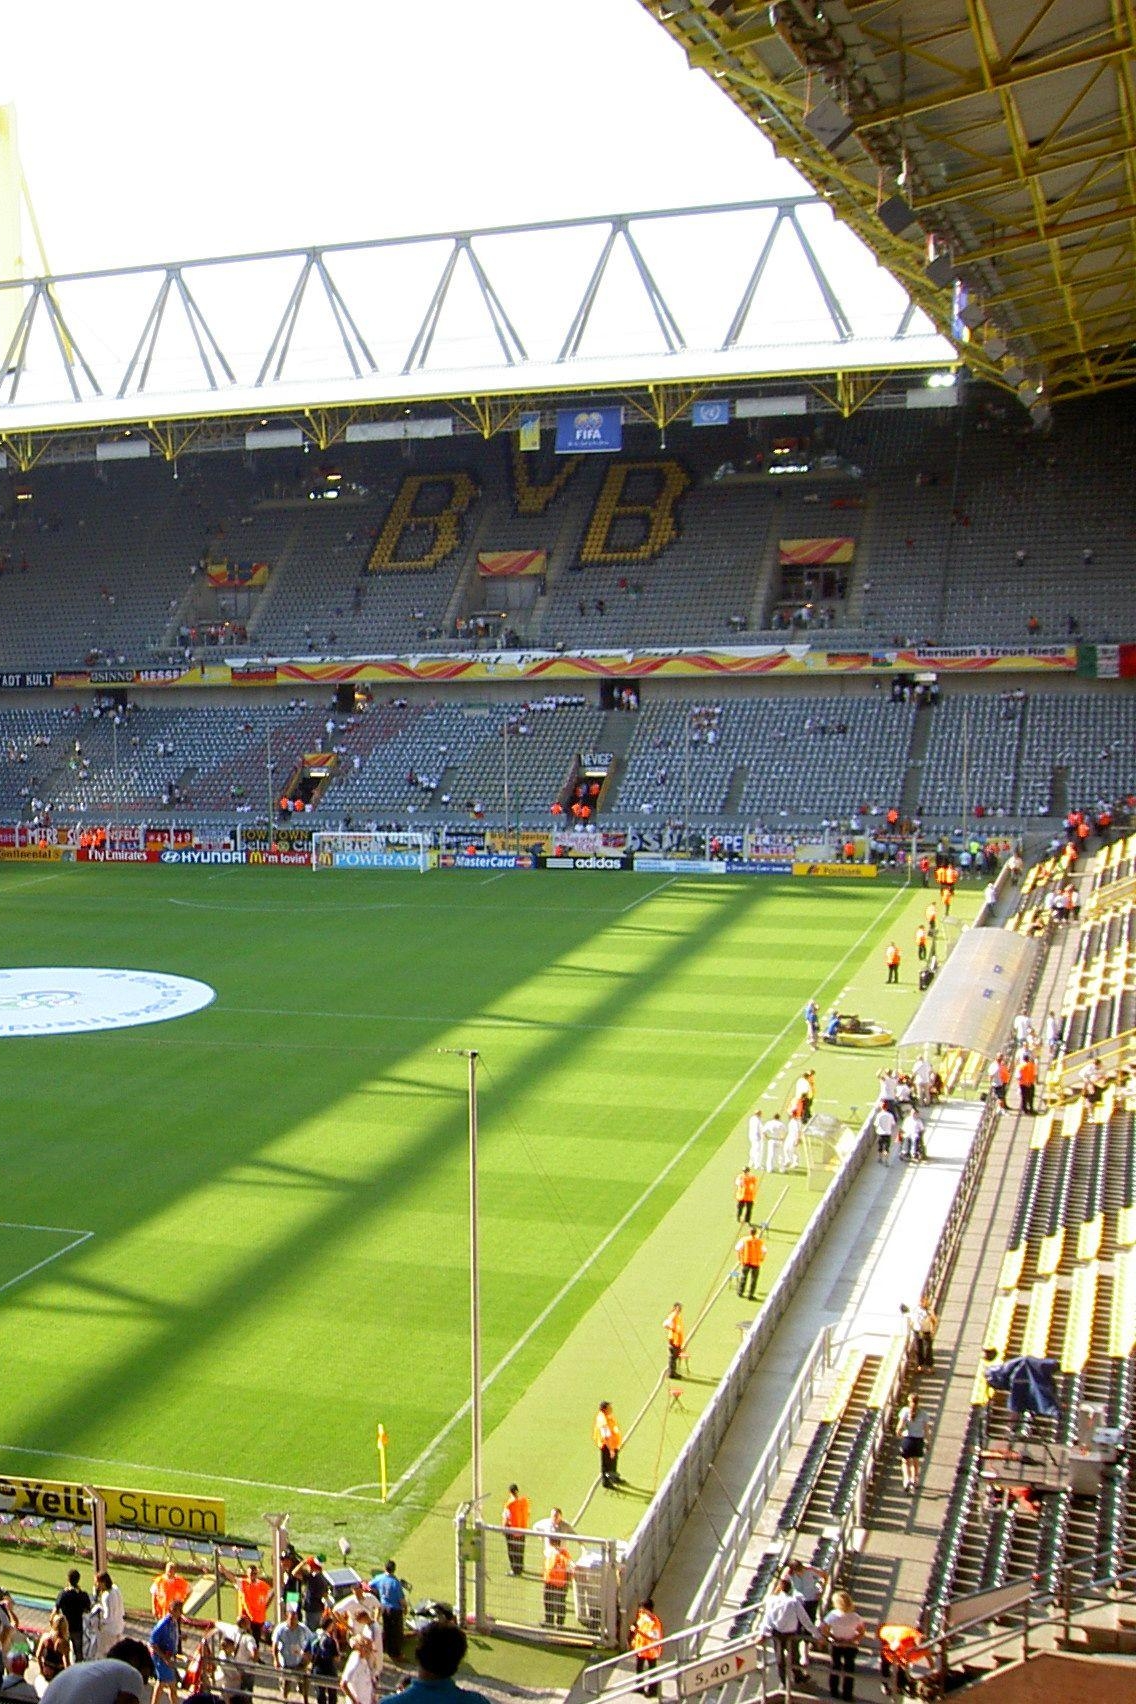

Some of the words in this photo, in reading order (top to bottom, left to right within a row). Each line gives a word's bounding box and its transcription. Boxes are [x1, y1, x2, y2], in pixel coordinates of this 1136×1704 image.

[575, 429, 601, 440] FIFA
[88, 849, 104, 862] Fly
[105, 850, 147, 861] Emirates
[181, 851, 246, 864] HYUNDAI
[280, 851, 308, 864] lovin'
[455, 856, 515, 868] MasterCard
[575, 857, 621, 869] adidas
[118, 1493, 218, 1533] Strom
[694, 1662, 730, 1687] 5,40
